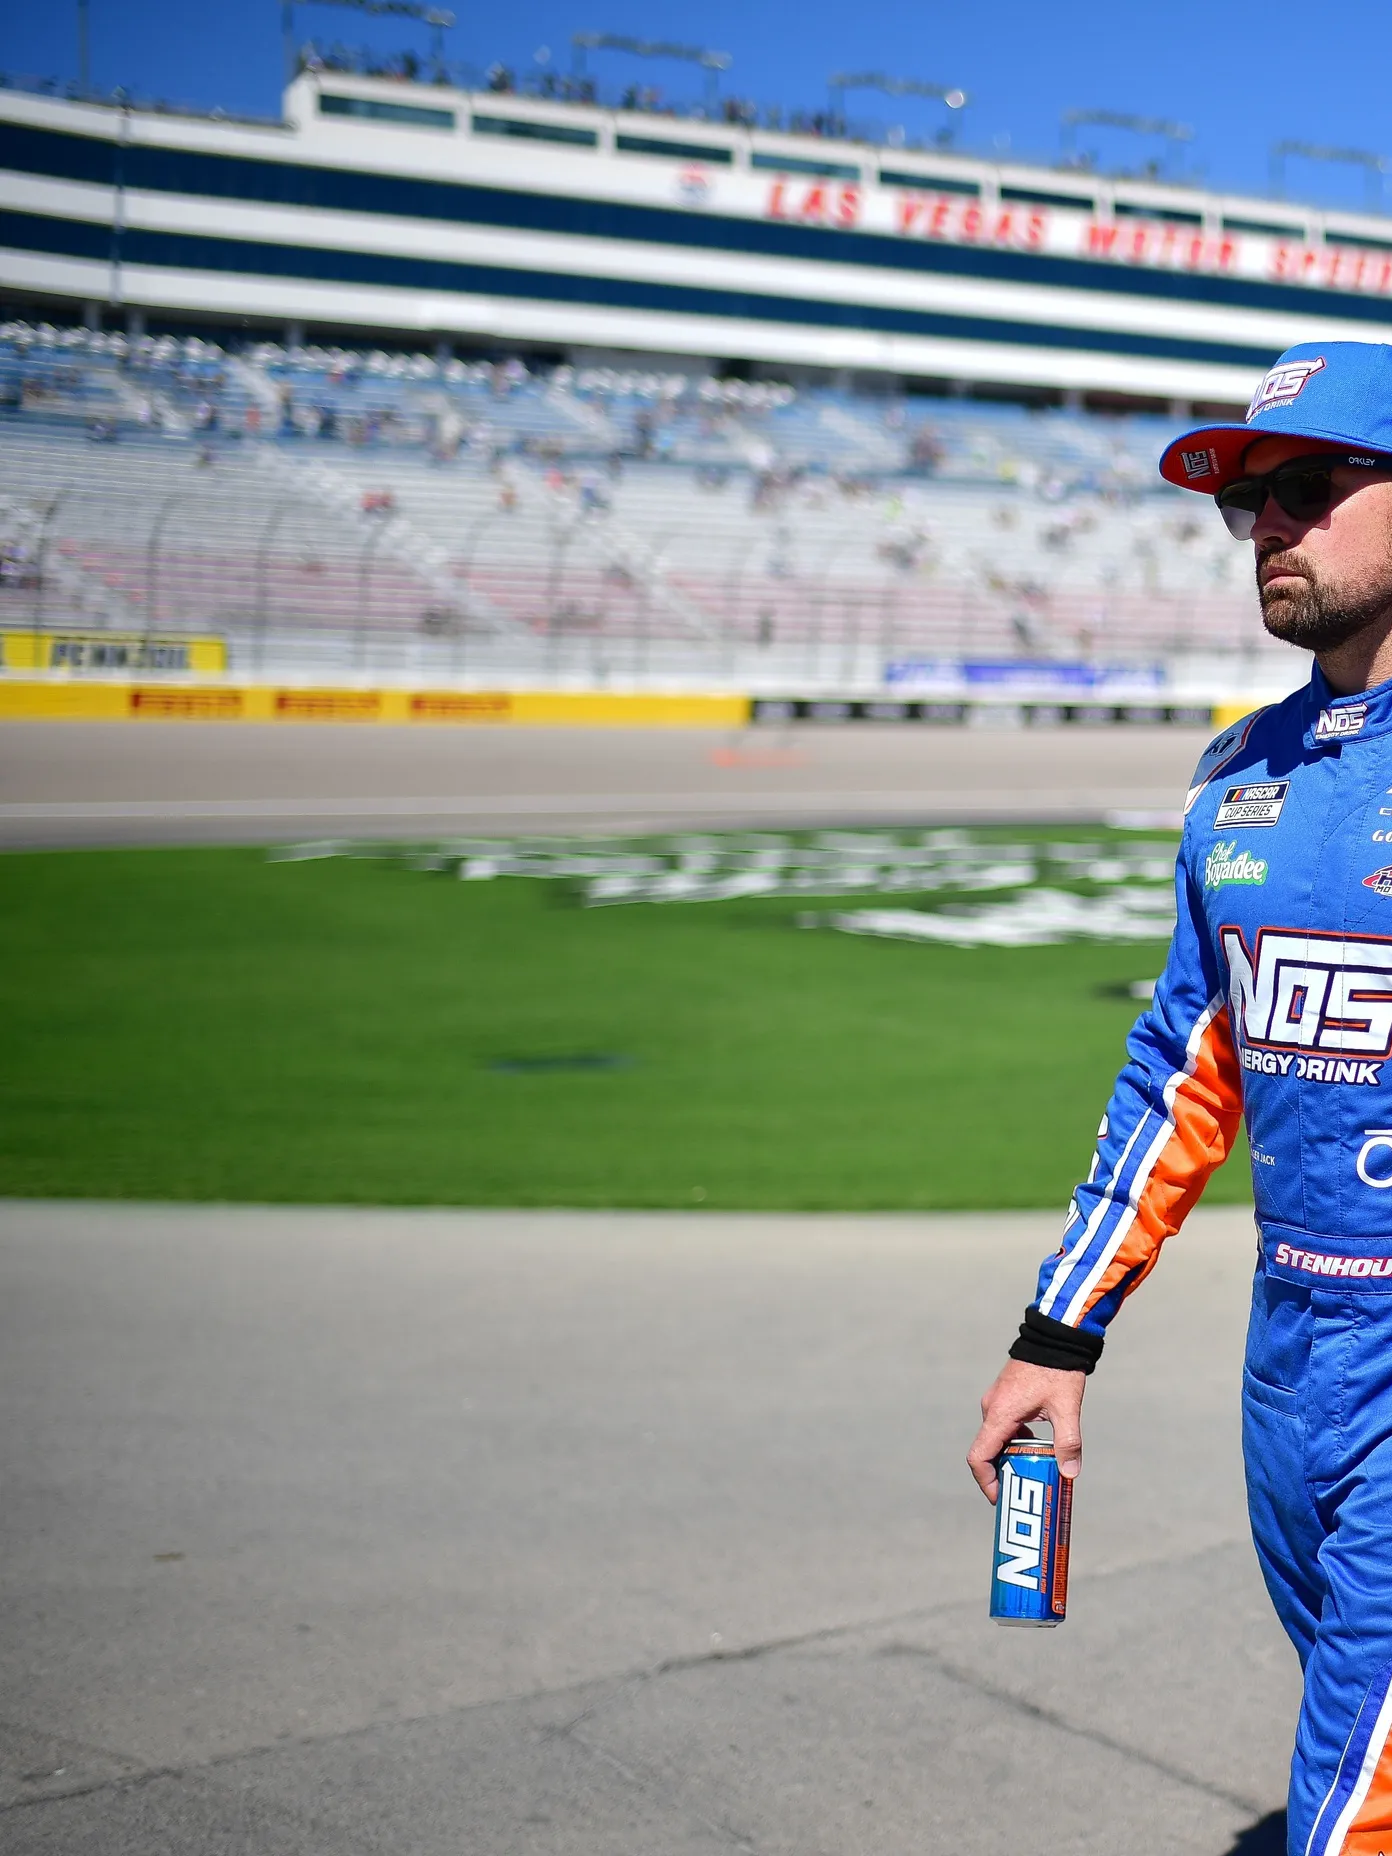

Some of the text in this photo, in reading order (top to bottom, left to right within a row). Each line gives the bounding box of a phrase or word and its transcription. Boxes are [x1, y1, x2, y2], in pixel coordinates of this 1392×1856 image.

[768, 174, 860, 228] LAS
[898, 191, 1045, 251] VEGAS
[1348, 456, 1376, 467] OAKLEY
[1316, 702, 1368, 733] NOS
[1241, 786, 1280, 800] NASCAR
[1224, 804, 1273, 819] CUP SERIES
[1212, 841, 1237, 863] Chef
[1204, 851, 1265, 887] Boyardee
[997, 1460, 1045, 1591] NOS
[1044, 1504, 1052, 1529] ENERGY
[1041, 1530, 1050, 1578] PERFORMANCE
